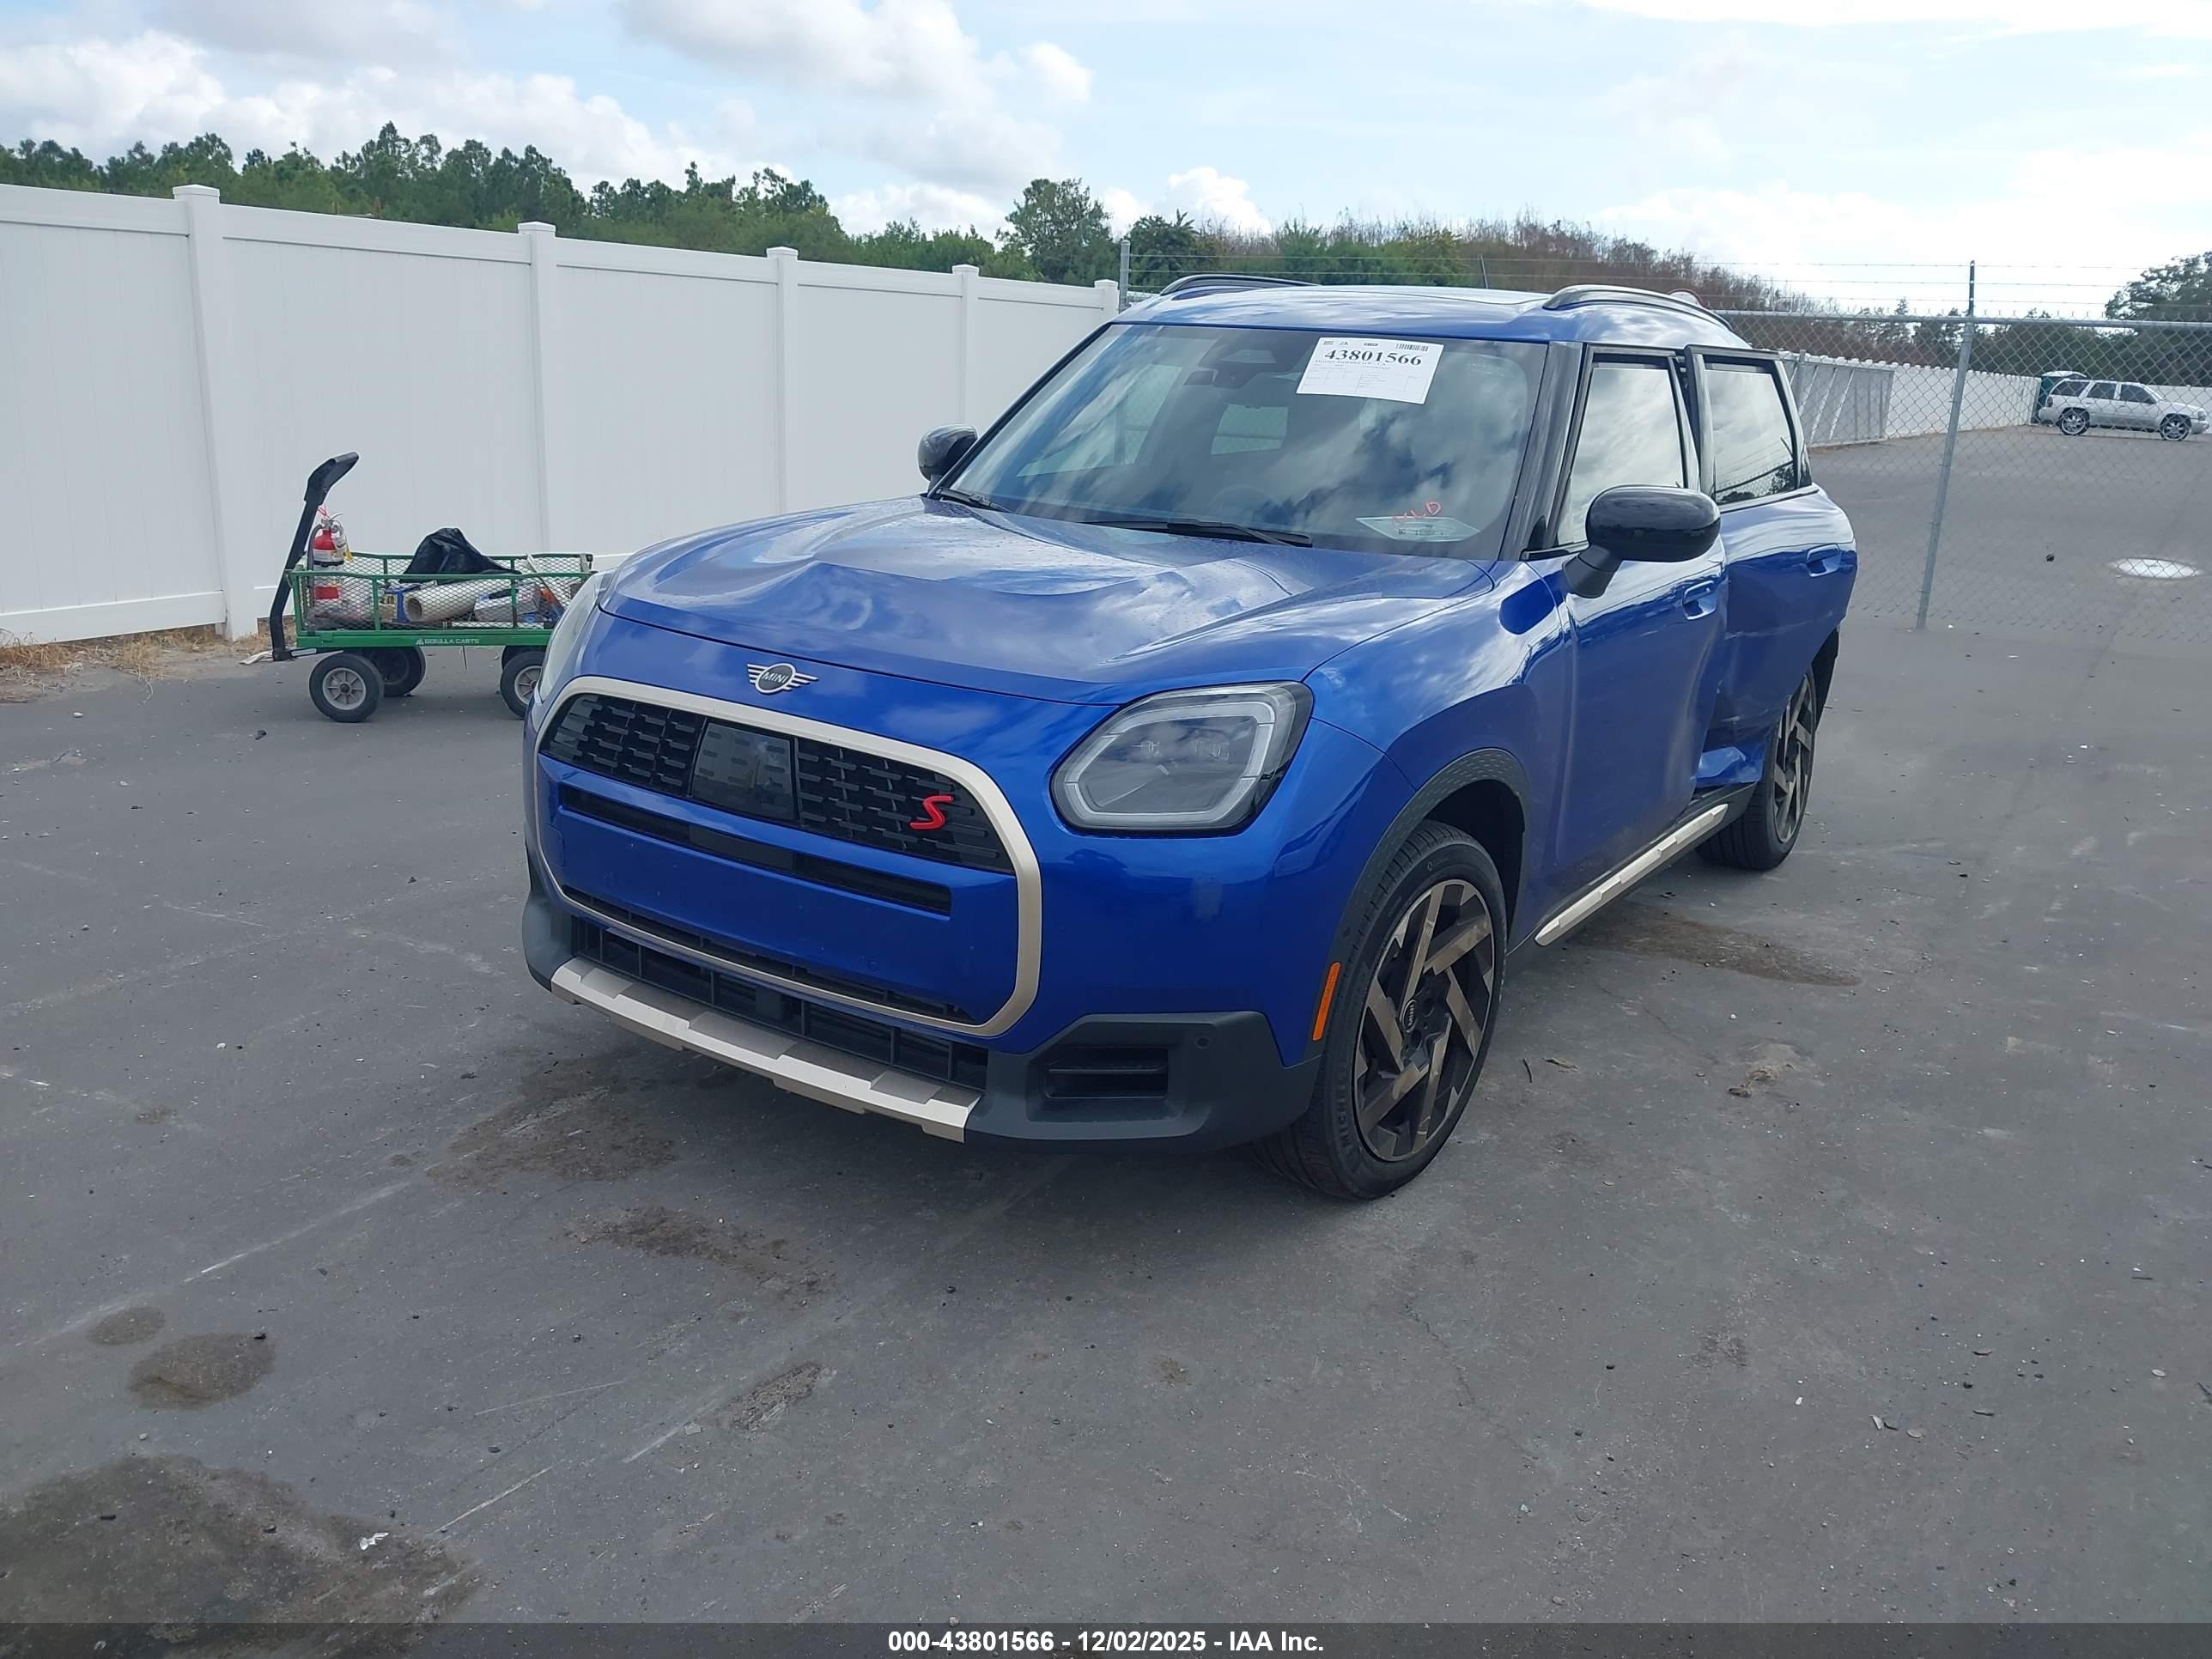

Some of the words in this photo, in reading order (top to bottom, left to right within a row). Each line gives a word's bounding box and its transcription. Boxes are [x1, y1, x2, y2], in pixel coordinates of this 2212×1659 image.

[1325, 349, 1423, 366] 43801566
[762, 672, 789, 684] MINI
[908, 795, 954, 830] S
